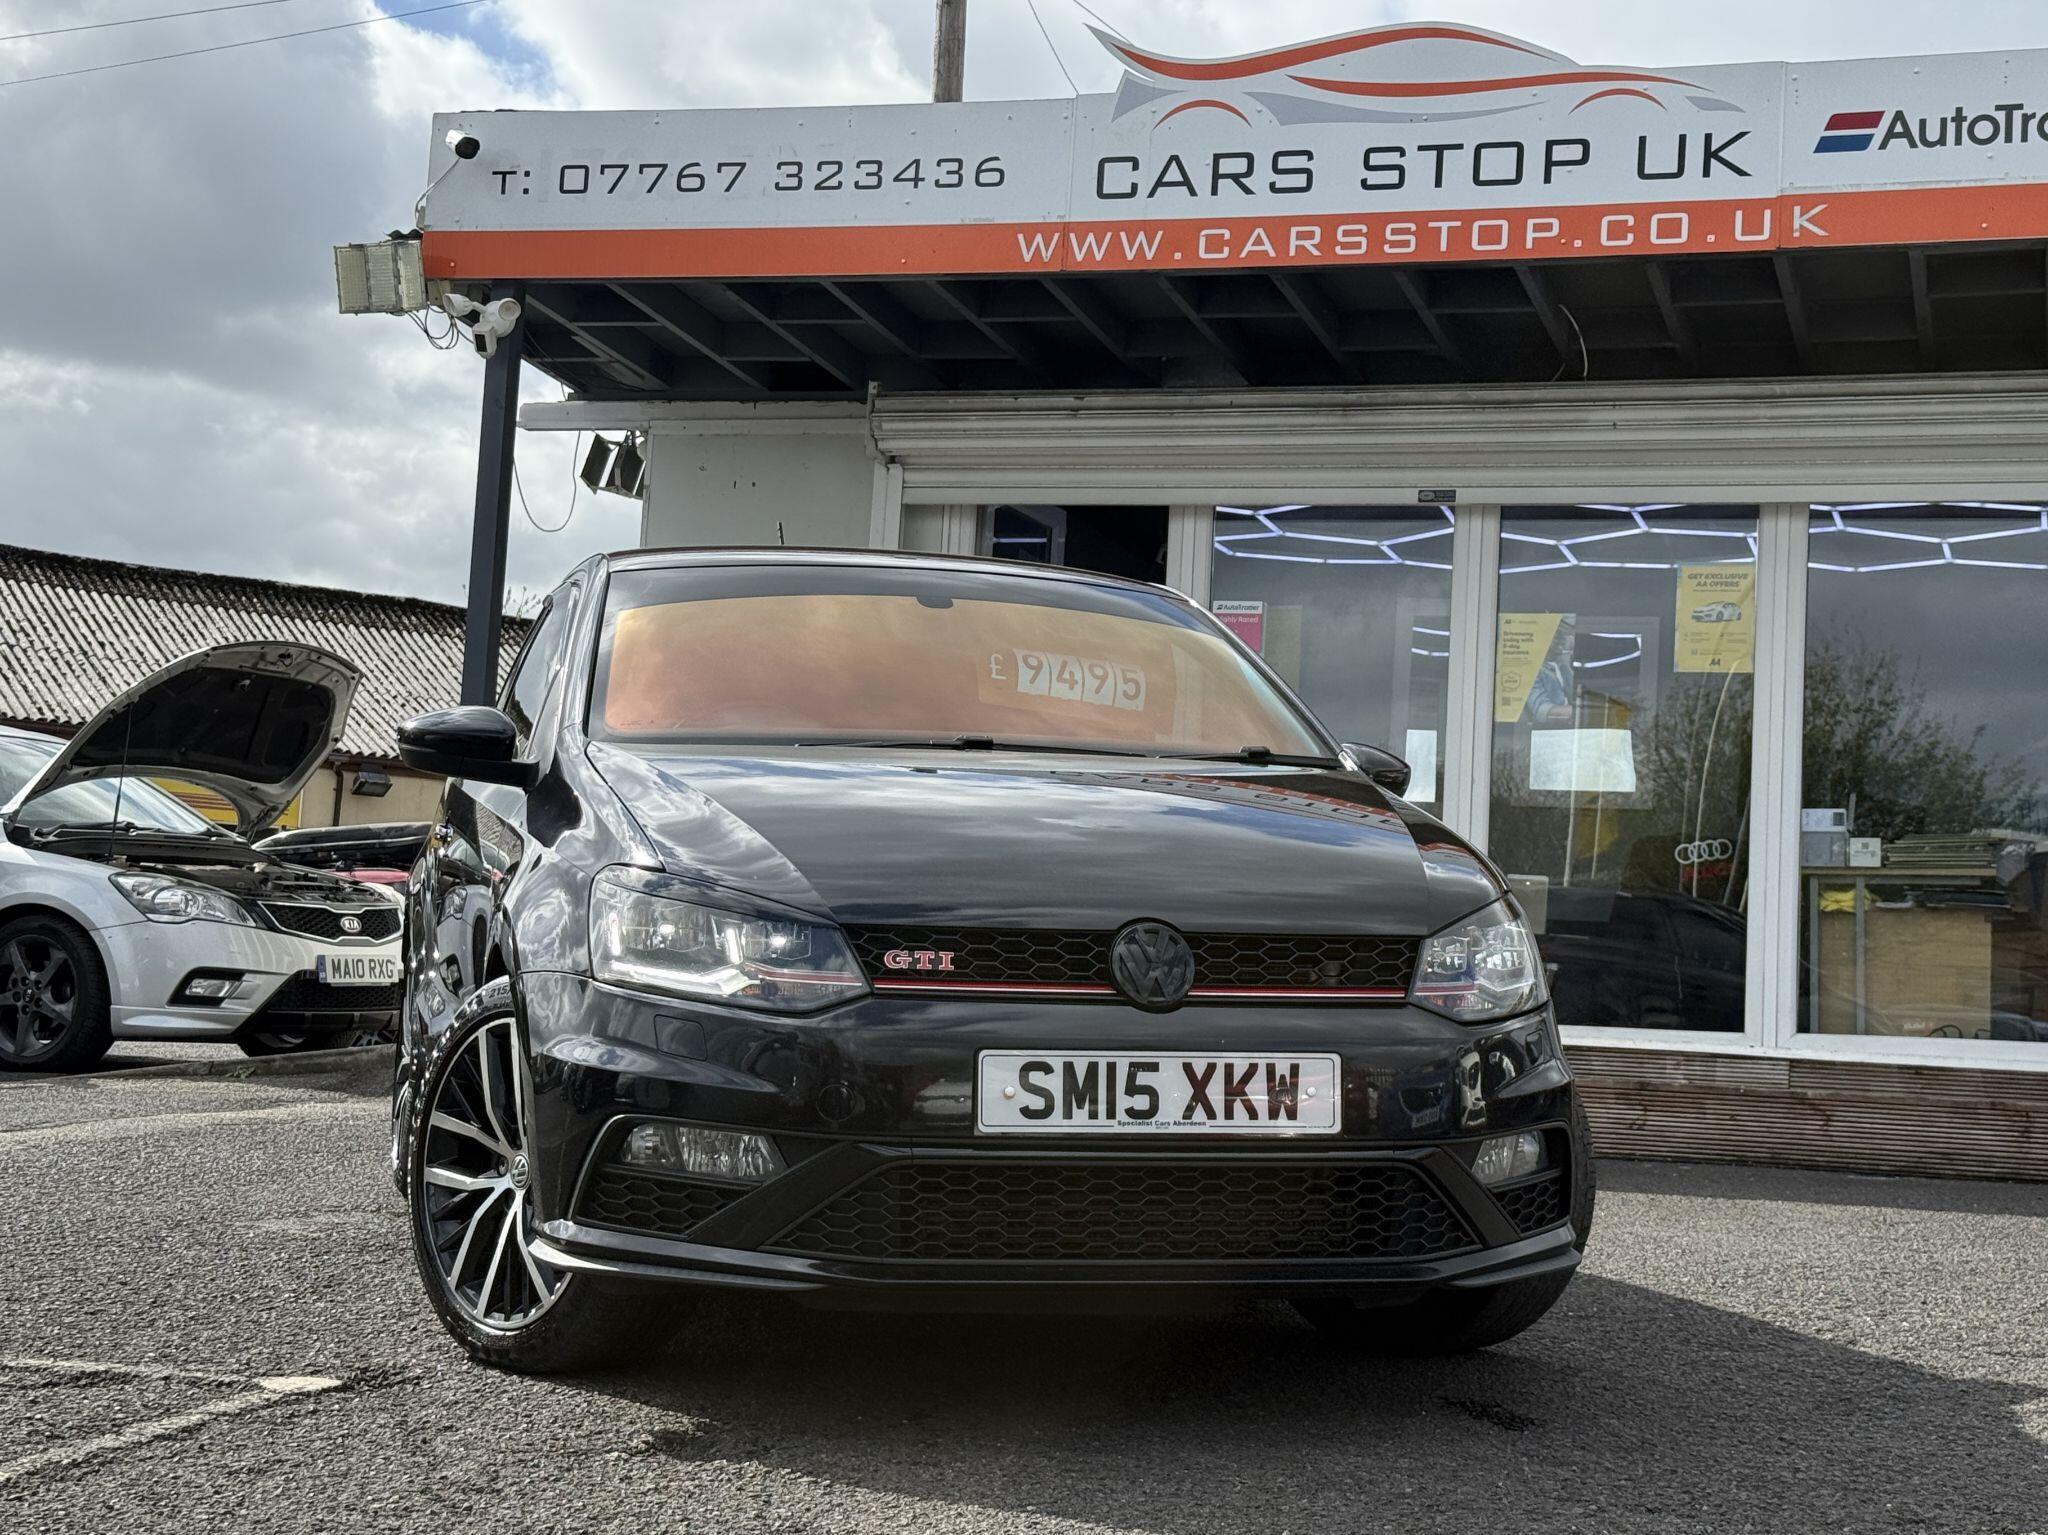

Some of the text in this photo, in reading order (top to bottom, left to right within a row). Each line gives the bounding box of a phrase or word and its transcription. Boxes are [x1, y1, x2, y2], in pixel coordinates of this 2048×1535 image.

[491, 155, 1007, 196] T: 07767 323436
[1095, 130, 1753, 200] CARS STOP UK
[1016, 203, 1830, 264] WWW.CARSSTOP.CO.UK
[1709, 580, 1740, 588] OFFERS
[343, 918, 360, 930] KIA
[331, 958, 396, 979] MA10 RXG
[883, 949, 955, 971] GTI
[1018, 1060, 1300, 1121] SM15 XKW
[1117, 1119, 1153, 1127] Specialist
[1172, 1119, 1207, 1127] Aberdeen
